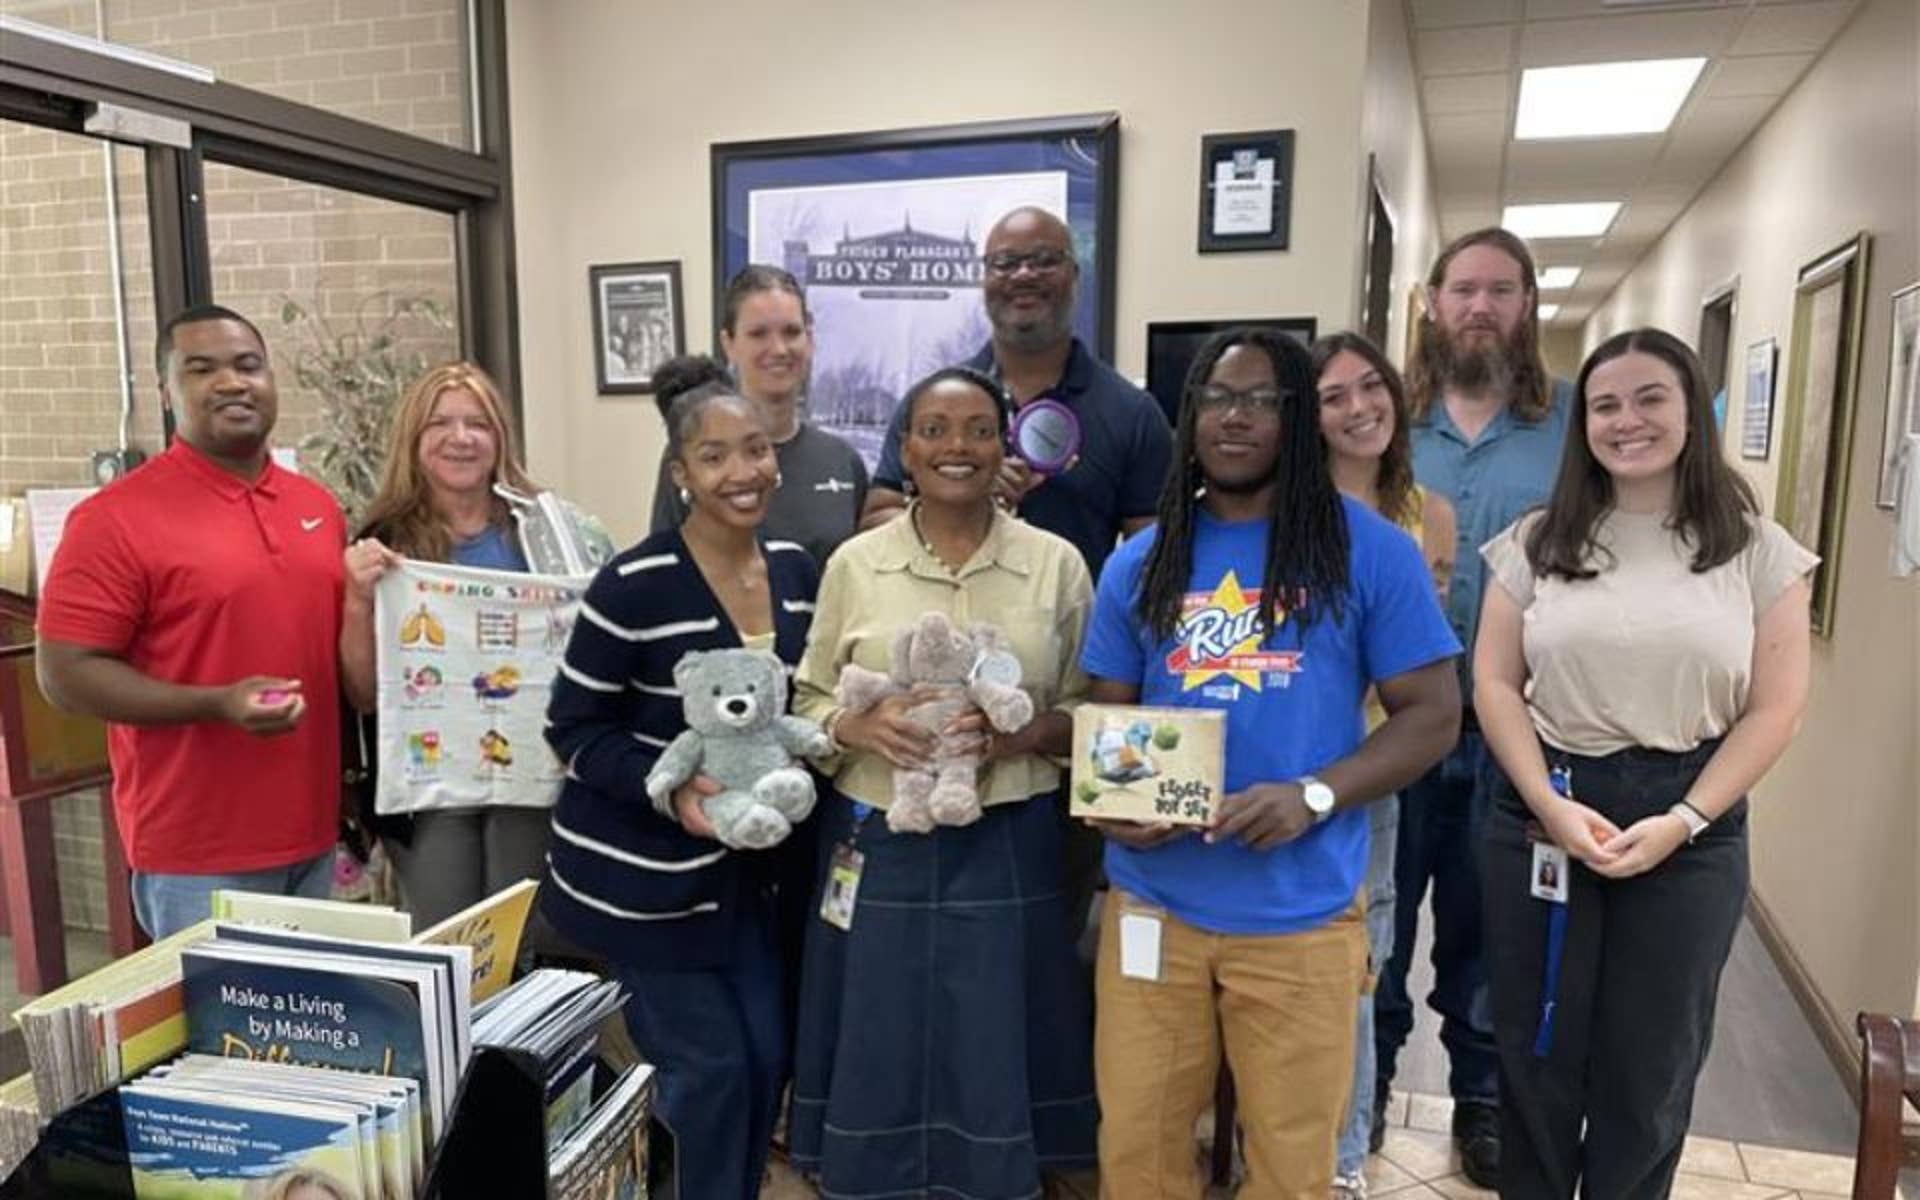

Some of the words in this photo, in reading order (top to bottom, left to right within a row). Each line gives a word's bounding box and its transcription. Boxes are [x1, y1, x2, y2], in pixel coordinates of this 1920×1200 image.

[816, 261, 898, 281] BOYS'
[220, 985, 269, 1009] Make
[273, 995, 284, 1009] a
[289, 993, 346, 1023] Living
[249, 1015, 272, 1041] by
[275, 1020, 346, 1049] Making
[348, 1031, 359, 1047] a
